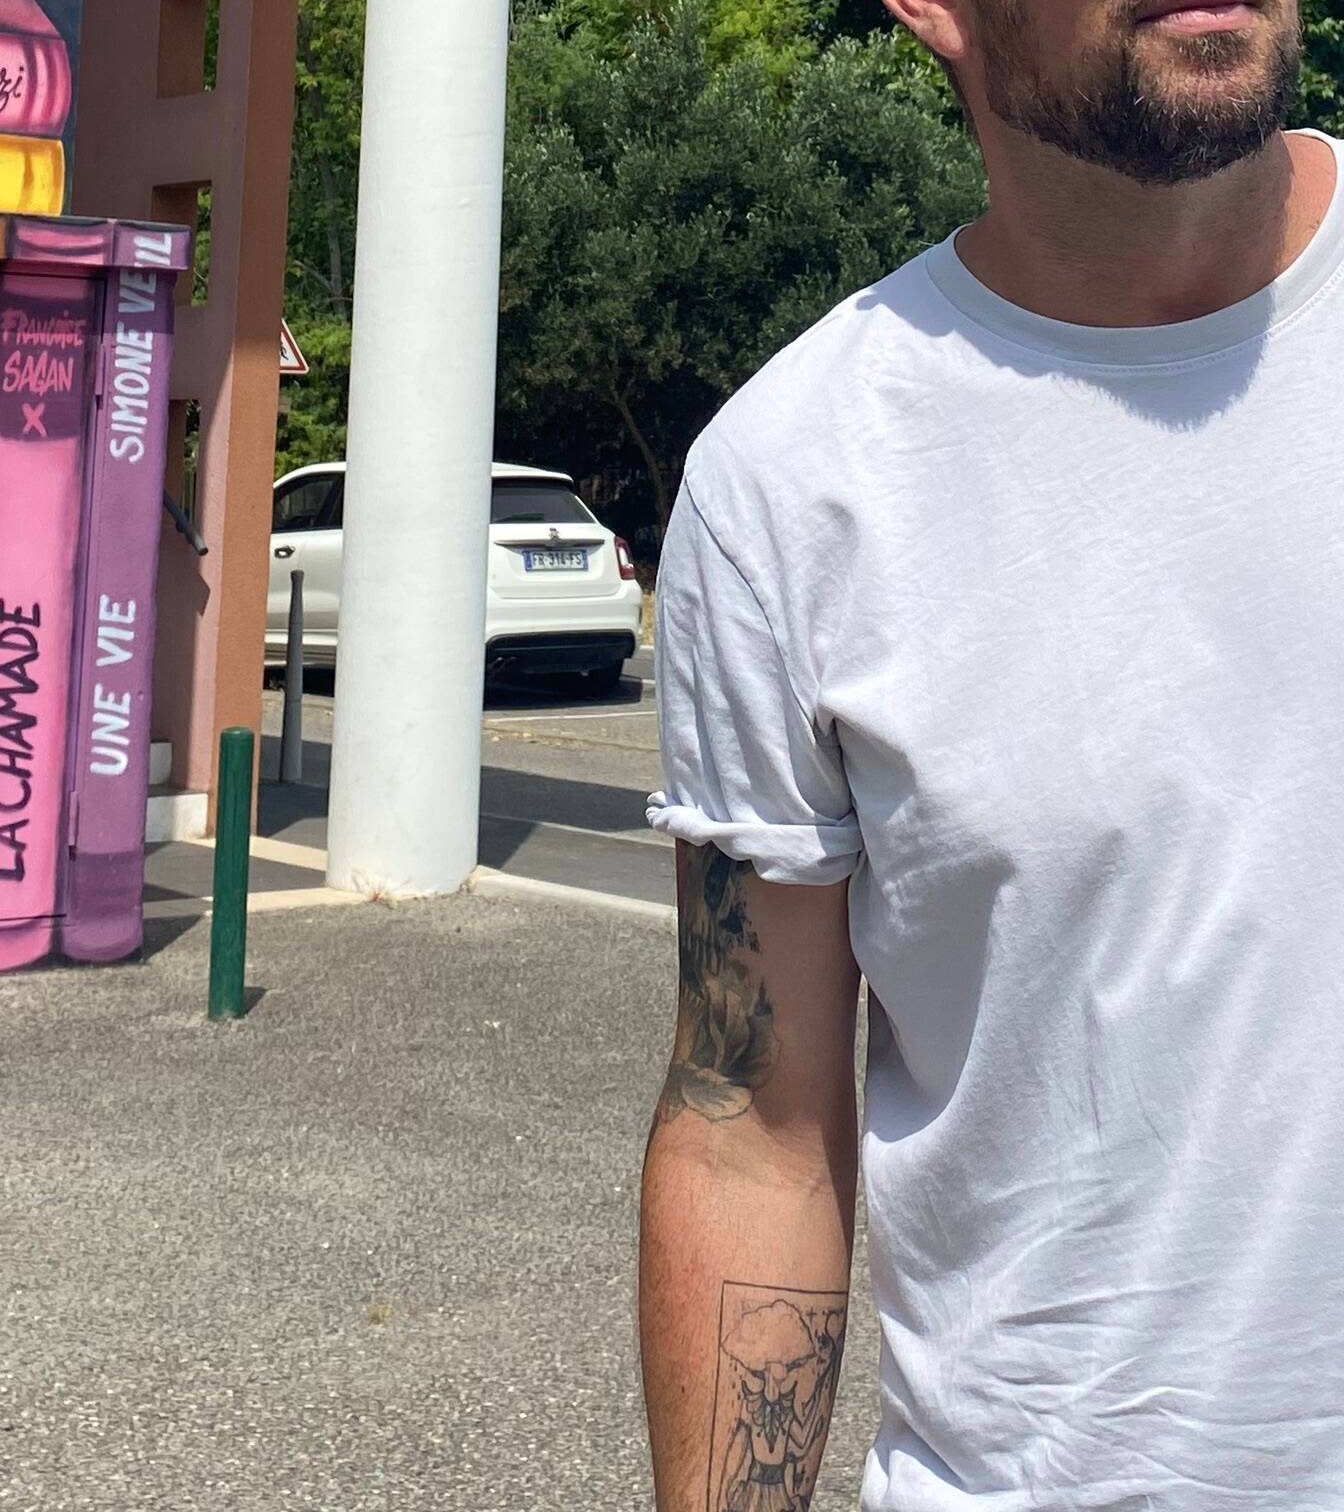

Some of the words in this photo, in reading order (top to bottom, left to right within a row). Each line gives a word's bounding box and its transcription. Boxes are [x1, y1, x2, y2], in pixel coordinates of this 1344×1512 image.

[2, 349, 75, 397] SAGAN
[108, 320, 154, 465] SIMONE
[95, 593, 137, 668] VIE
[89, 682, 132, 777] UNE
